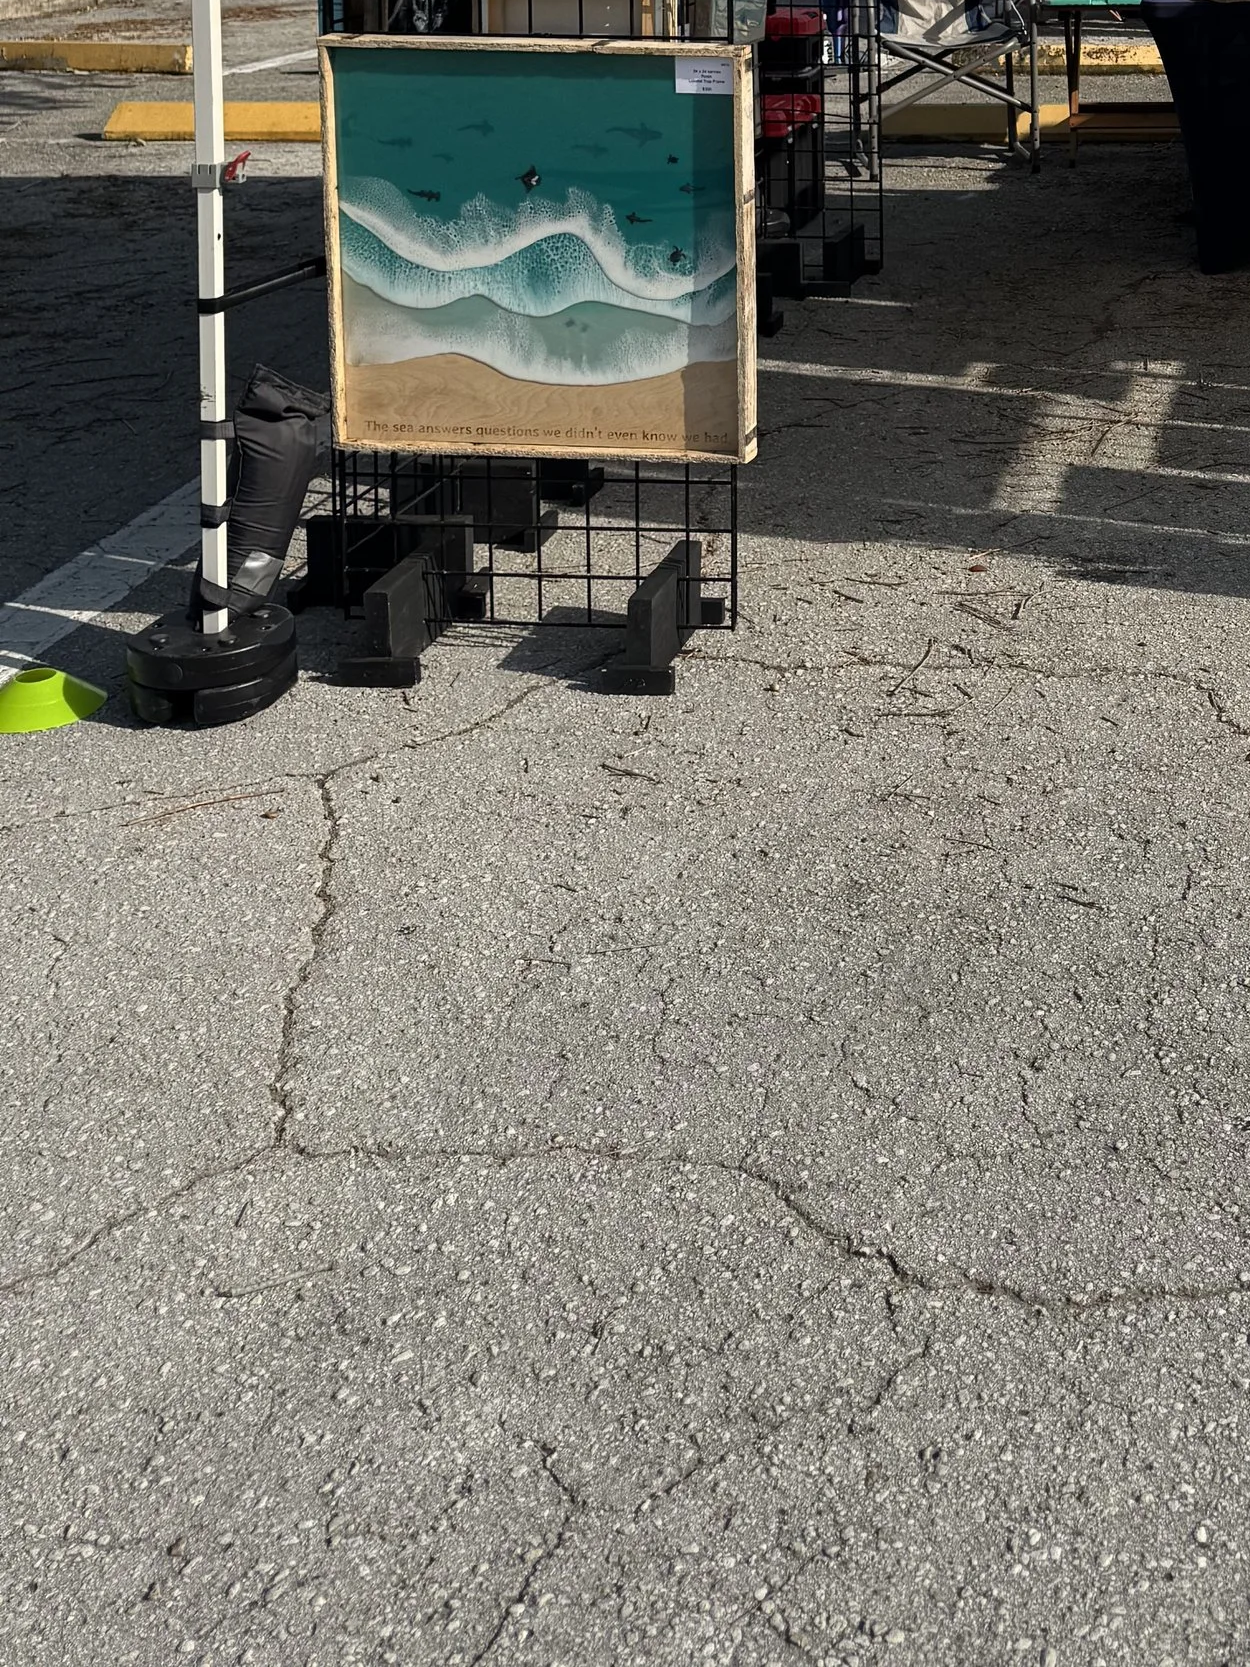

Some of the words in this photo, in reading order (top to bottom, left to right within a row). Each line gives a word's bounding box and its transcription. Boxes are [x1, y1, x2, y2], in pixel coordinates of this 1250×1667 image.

[365, 420, 389, 432] The
[392, 423, 414, 432] sea
[418, 424, 472, 435] answers
[476, 425, 540, 440] questions
[543, 429, 561, 438] we
[565, 426, 603, 439] didn't
[607, 431, 638, 441] even
[642, 430, 677, 442] know
[683, 434, 700, 443] we
